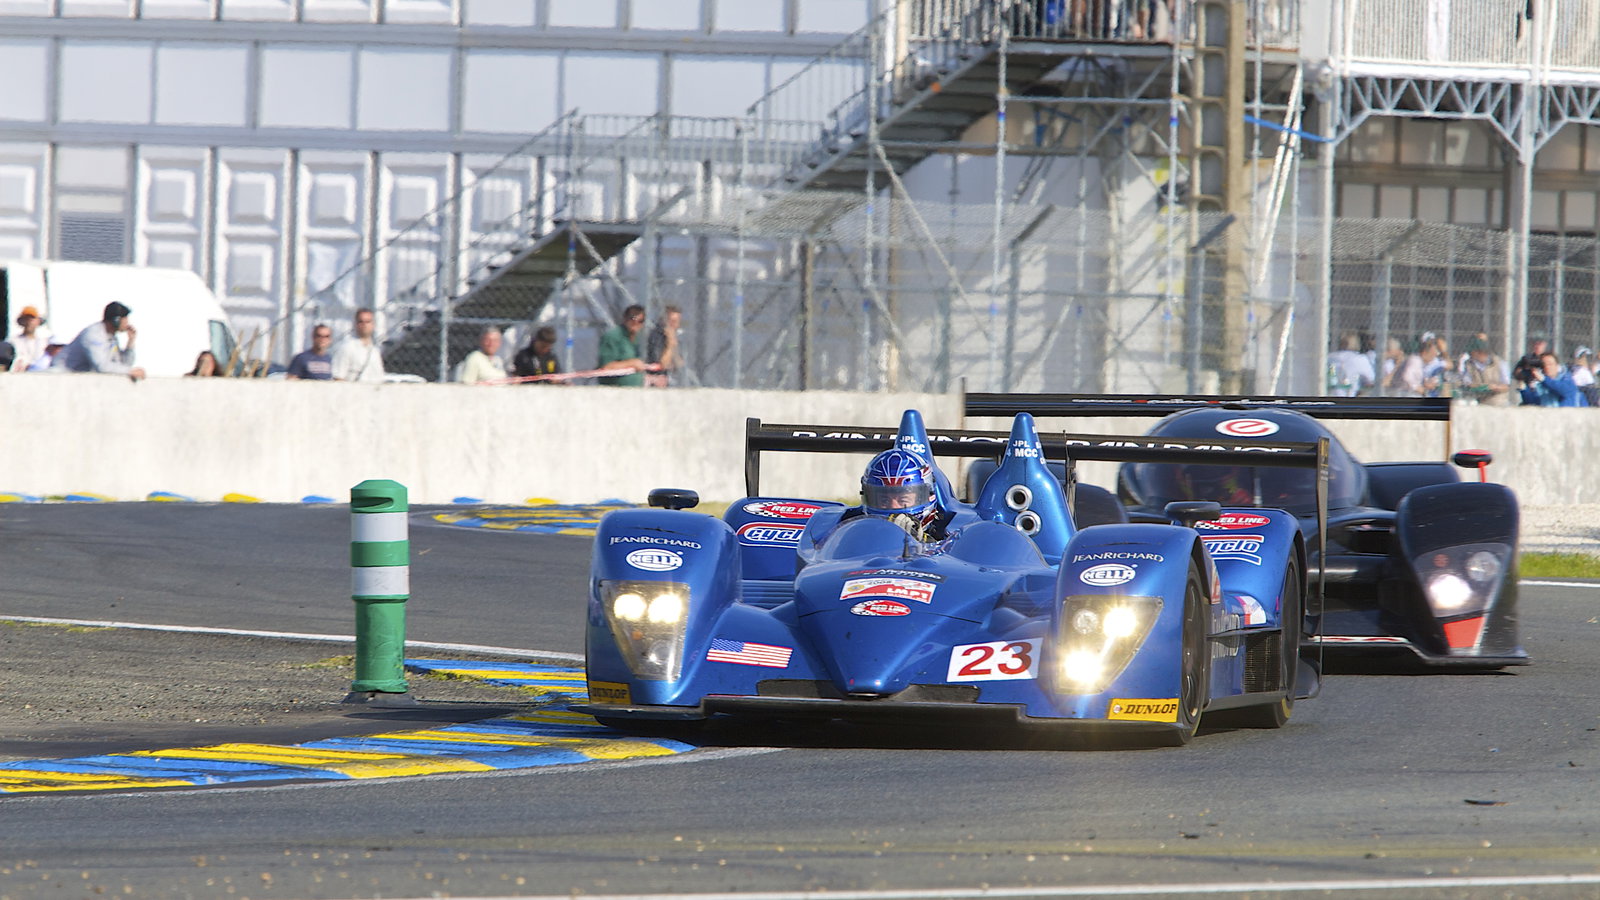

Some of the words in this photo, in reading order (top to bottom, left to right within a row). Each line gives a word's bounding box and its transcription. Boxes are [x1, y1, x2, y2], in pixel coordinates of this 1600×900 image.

[900, 435, 917, 443] JPL
[1015, 448, 1039, 458] MCC
[746, 527, 804, 542] cycl
[1205, 540, 1260, 554] yclo
[630, 554, 684, 568] HELLA
[1084, 569, 1136, 581] HELLA
[886, 587, 929, 599] LMP1
[957, 641, 1033, 677] 23
[1123, 703, 1178, 715] DUNLOP
